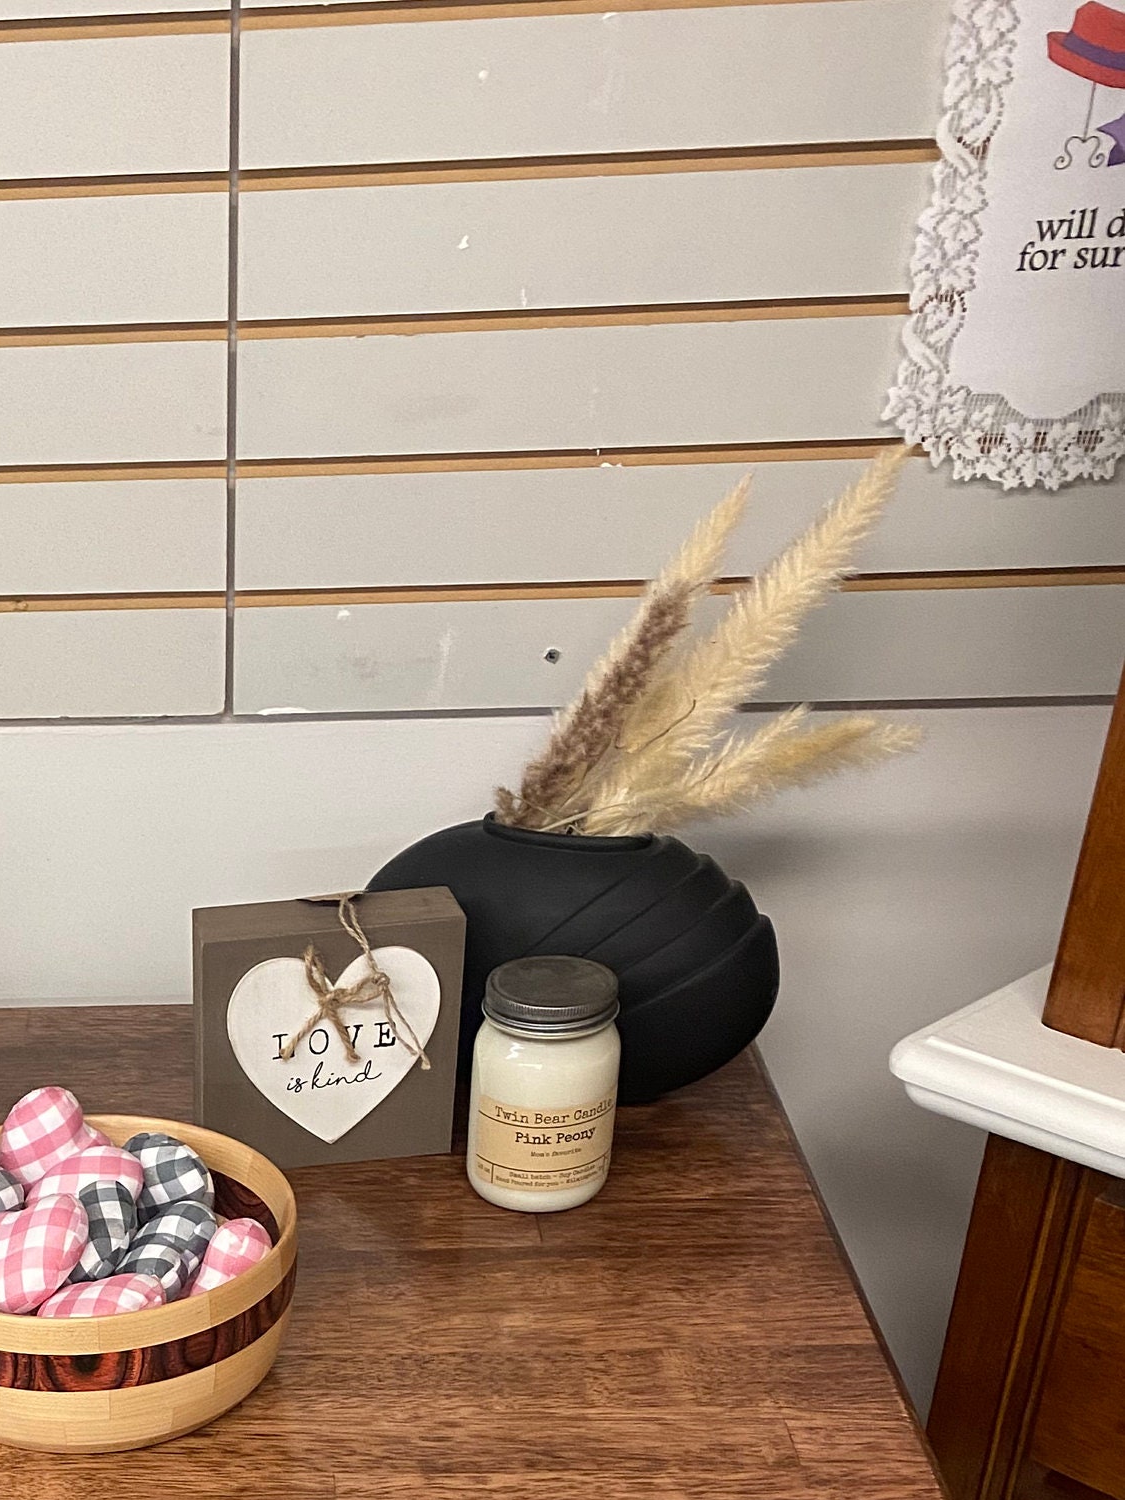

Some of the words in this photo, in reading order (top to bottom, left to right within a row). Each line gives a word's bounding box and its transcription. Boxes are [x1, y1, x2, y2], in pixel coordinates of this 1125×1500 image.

[1036, 207, 1099, 242] will
[1015, 241, 1067, 272] for
[1073, 246, 1125, 270] sur
[272, 1021, 396, 1060] LOVE
[286, 1077, 308, 1093] is
[311, 1060, 383, 1090] kind
[495, 1105, 529, 1124] Twin
[535, 1113, 570, 1125] Bear
[515, 1131, 552, 1145] Pink
[556, 1126, 596, 1145] Peony
